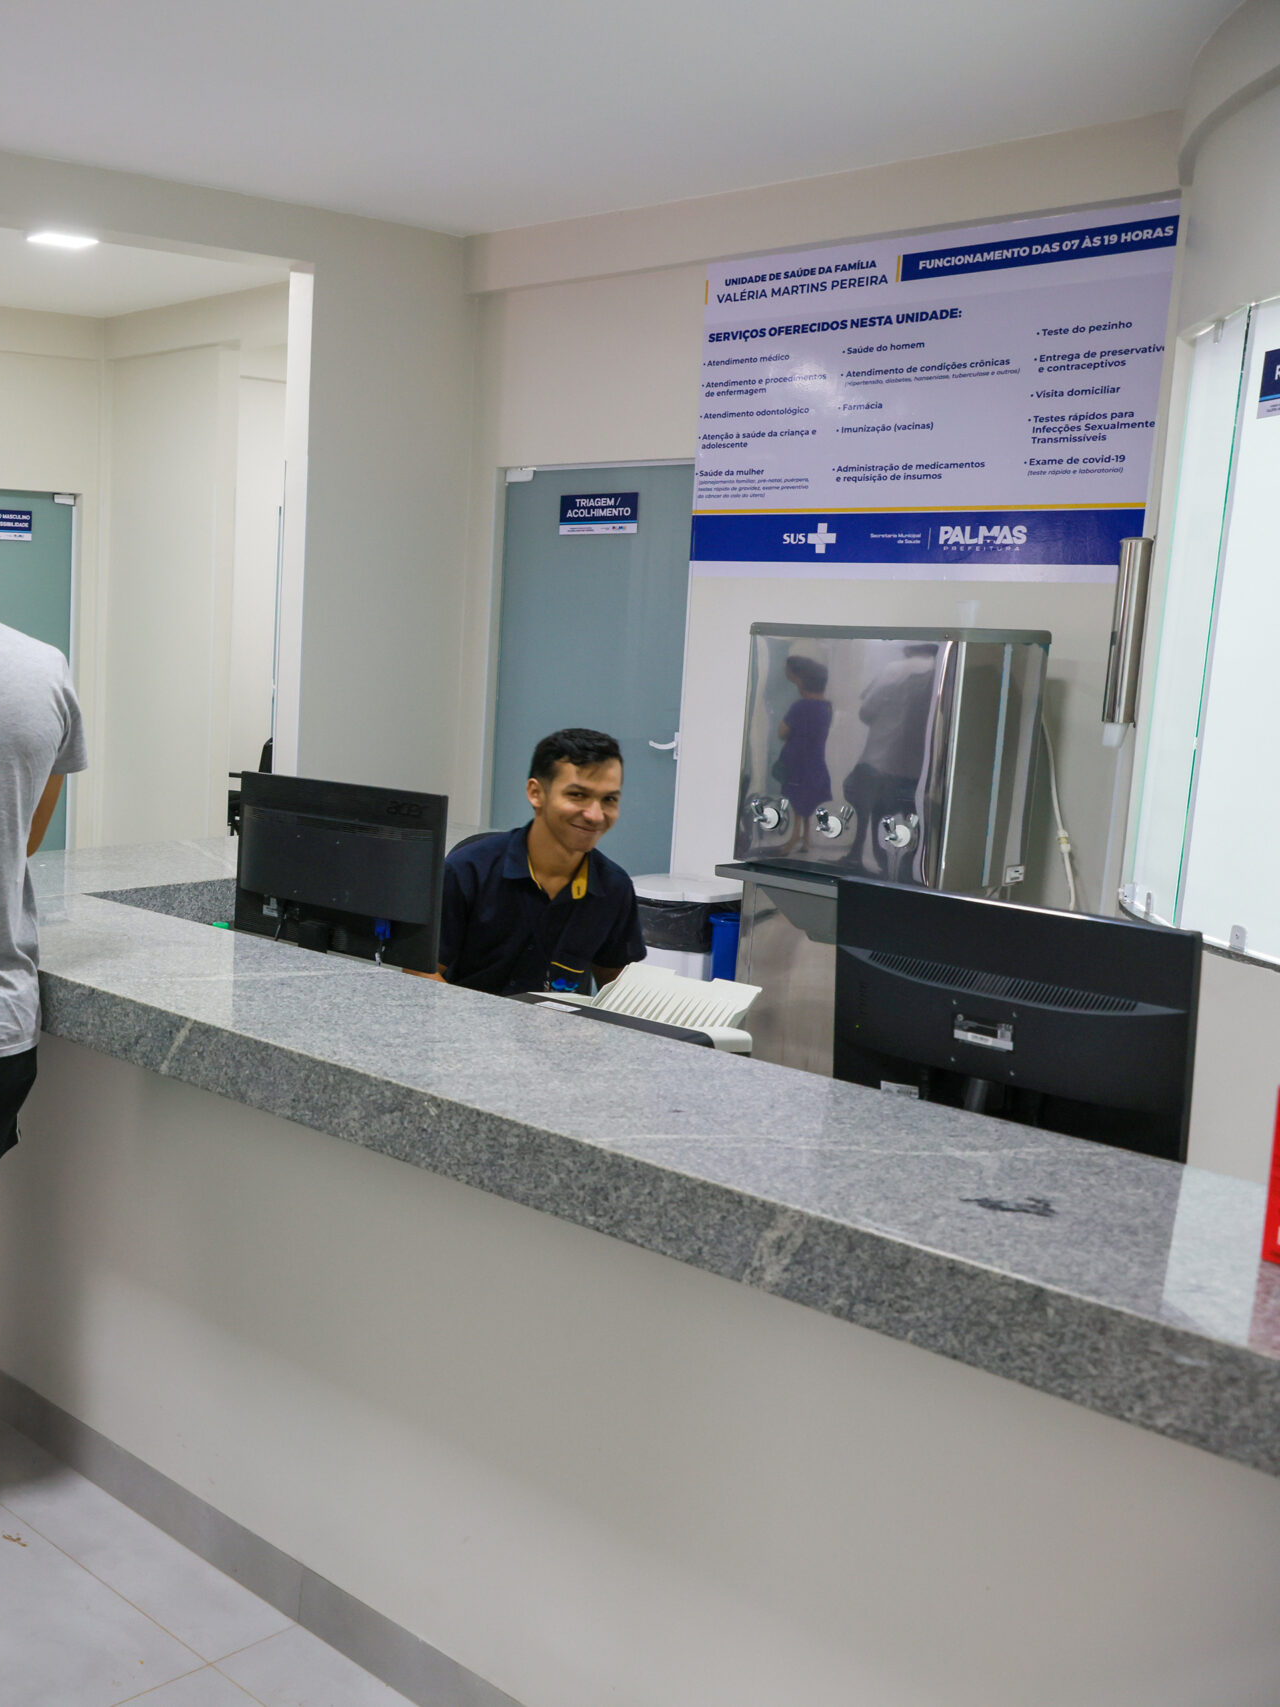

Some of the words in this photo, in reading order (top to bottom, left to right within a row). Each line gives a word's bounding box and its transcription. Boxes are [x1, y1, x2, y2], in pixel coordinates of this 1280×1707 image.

[919, 247, 1029, 270] FUNCIONAMENTO
[1032, 242, 1060, 255] DAS
[1062, 239, 1080, 251] 07
[1082, 235, 1101, 249] ÀS
[1103, 234, 1118, 246] 19
[1120, 225, 1174, 243] HORAS
[725, 273, 767, 286] UNIDADE
[768, 272, 782, 282] DE
[783, 267, 816, 279] SAÚDE
[818, 265, 832, 275] DA
[834, 260, 877, 273] FAMÍLIA
[717, 287, 768, 304] VALÉRIA
[771, 281, 828, 298] MARTINS
[831, 274, 888, 291] PEREIRA
[708, 328, 766, 343] SERVIÇOS
[768, 319, 848, 337] OFERECIDOS
[850, 315, 893, 329] NESTA
[895, 308, 962, 325] UNIDADE:
[1042, 327, 1069, 336] Teste
[1072, 325, 1086, 334] do
[1088, 321, 1132, 334] pezinho
[847, 344, 874, 355] Saúde
[876, 343, 888, 352] do
[890, 341, 925, 351] homem
[1039, 351, 1081, 363] Entrega
[1083, 350, 1097, 359] de
[1100, 344, 1165, 359] preservativ
[707, 356, 758, 367] Atendimento
[759, 354, 790, 363] médico
[1047, 359, 1127, 373] contraceptivos
[846, 366, 904, 378] Atendimento
[906, 364, 918, 373] de
[920, 361, 967, 372] condições
[969, 358, 1011, 368] crônicas
[705, 378, 757, 389] Atendimento
[765, 373, 827, 385] procedimentos
[705, 389, 715, 398] de
[716, 387, 767, 397] enfermagem
[1036, 389, 1064, 398] Visita
[1067, 385, 1121, 397] domiciliar
[703, 409, 754, 419] Atendimento
[755, 406, 810, 416] odontológico
[842, 402, 883, 411] Farmácia
[1033, 414, 1065, 423] Testes
[1068, 411, 1108, 422] rápidos
[1110, 411, 1135, 421] para
[841, 424, 892, 434] Imunização
[893, 421, 934, 432] (vacinas)
[1032, 424, 1082, 434] Infecções
[1084, 420, 1156, 431] Sexualmente
[701, 432, 734, 441] Atenção
[742, 430, 766, 439] saúde
[767, 429, 778, 437] da
[779, 428, 809, 437] criança
[1031, 433, 1107, 444] Transmissíveis
[701, 441, 748, 450] adolescente
[837, 463, 900, 473] Administração
[902, 462, 914, 471] de
[915, 460, 986, 470] medicamentos
[1029, 457, 1064, 466] Exame
[1066, 456, 1080, 465] de
[1082, 454, 1126, 464] covid-19
[699, 468, 723, 477] Saúde
[724, 468, 734, 476] da
[736, 467, 765, 476] mulher
[843, 473, 888, 483] requisição
[890, 473, 902, 481] de
[903, 472, 942, 480] insumos
[576, 497, 615, 507] TRIAGEM
[616, 497, 621, 506] /
[566, 507, 631, 518] ACOLHIMENTO
[783, 533, 806, 544] SUS
[939, 525, 1028, 545] PALMAS
